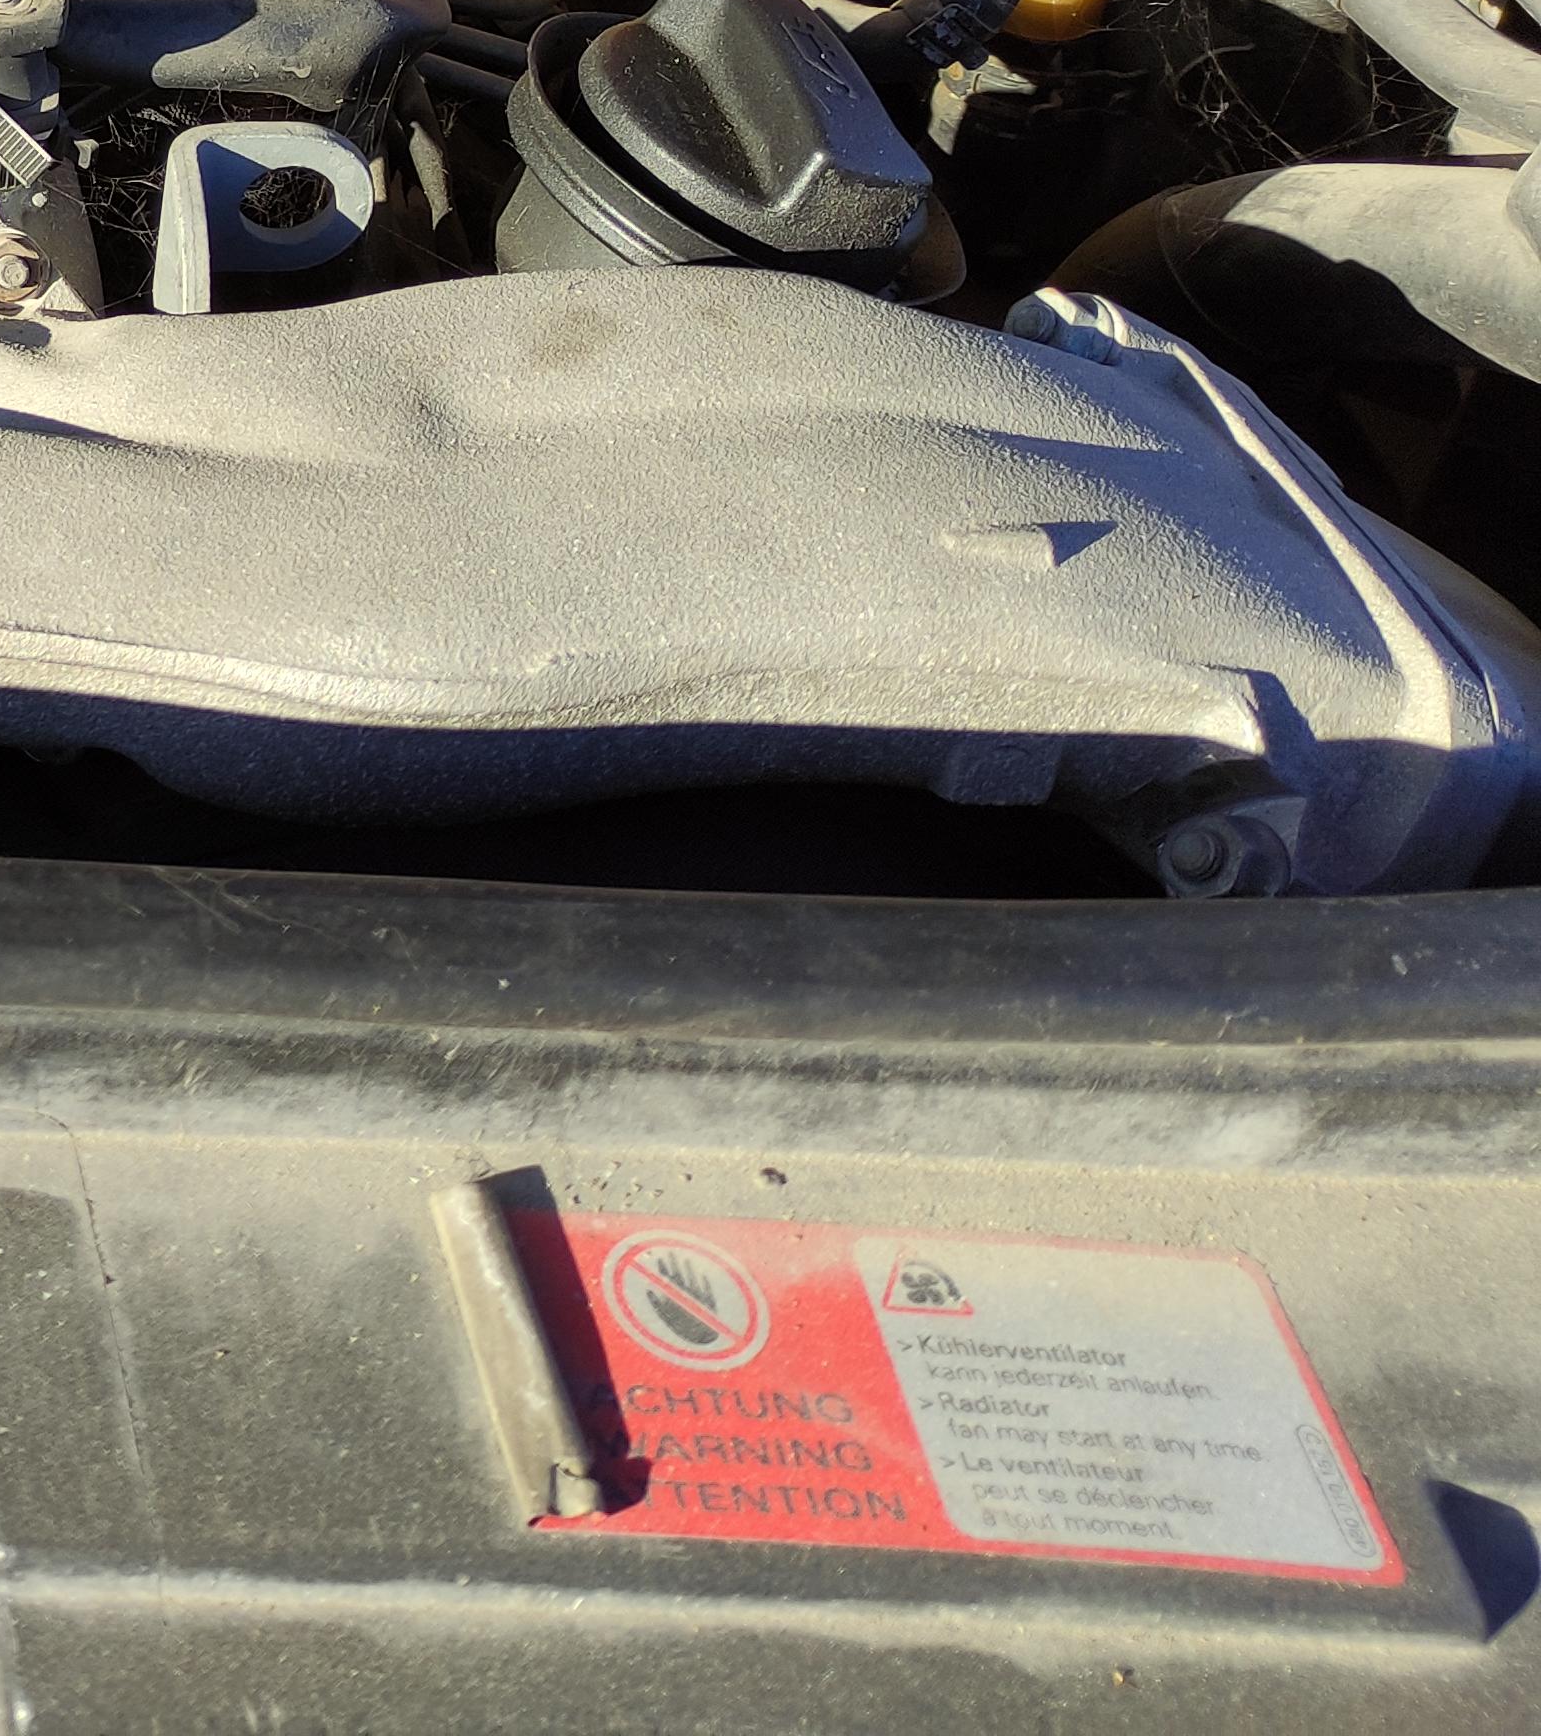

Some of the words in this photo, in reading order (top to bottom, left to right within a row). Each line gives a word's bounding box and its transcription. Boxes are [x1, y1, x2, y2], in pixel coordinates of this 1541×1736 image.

[938, 1391, 1050, 1418] Radiator
[997, 1426, 1049, 1448] may
[1154, 1435, 1197, 1460] any
[961, 1451, 994, 1473] Le
[1000, 1455, 1144, 1483] ventilateur
[629, 1477, 906, 1523] TTENTION
[1038, 1487, 1068, 1505] se
